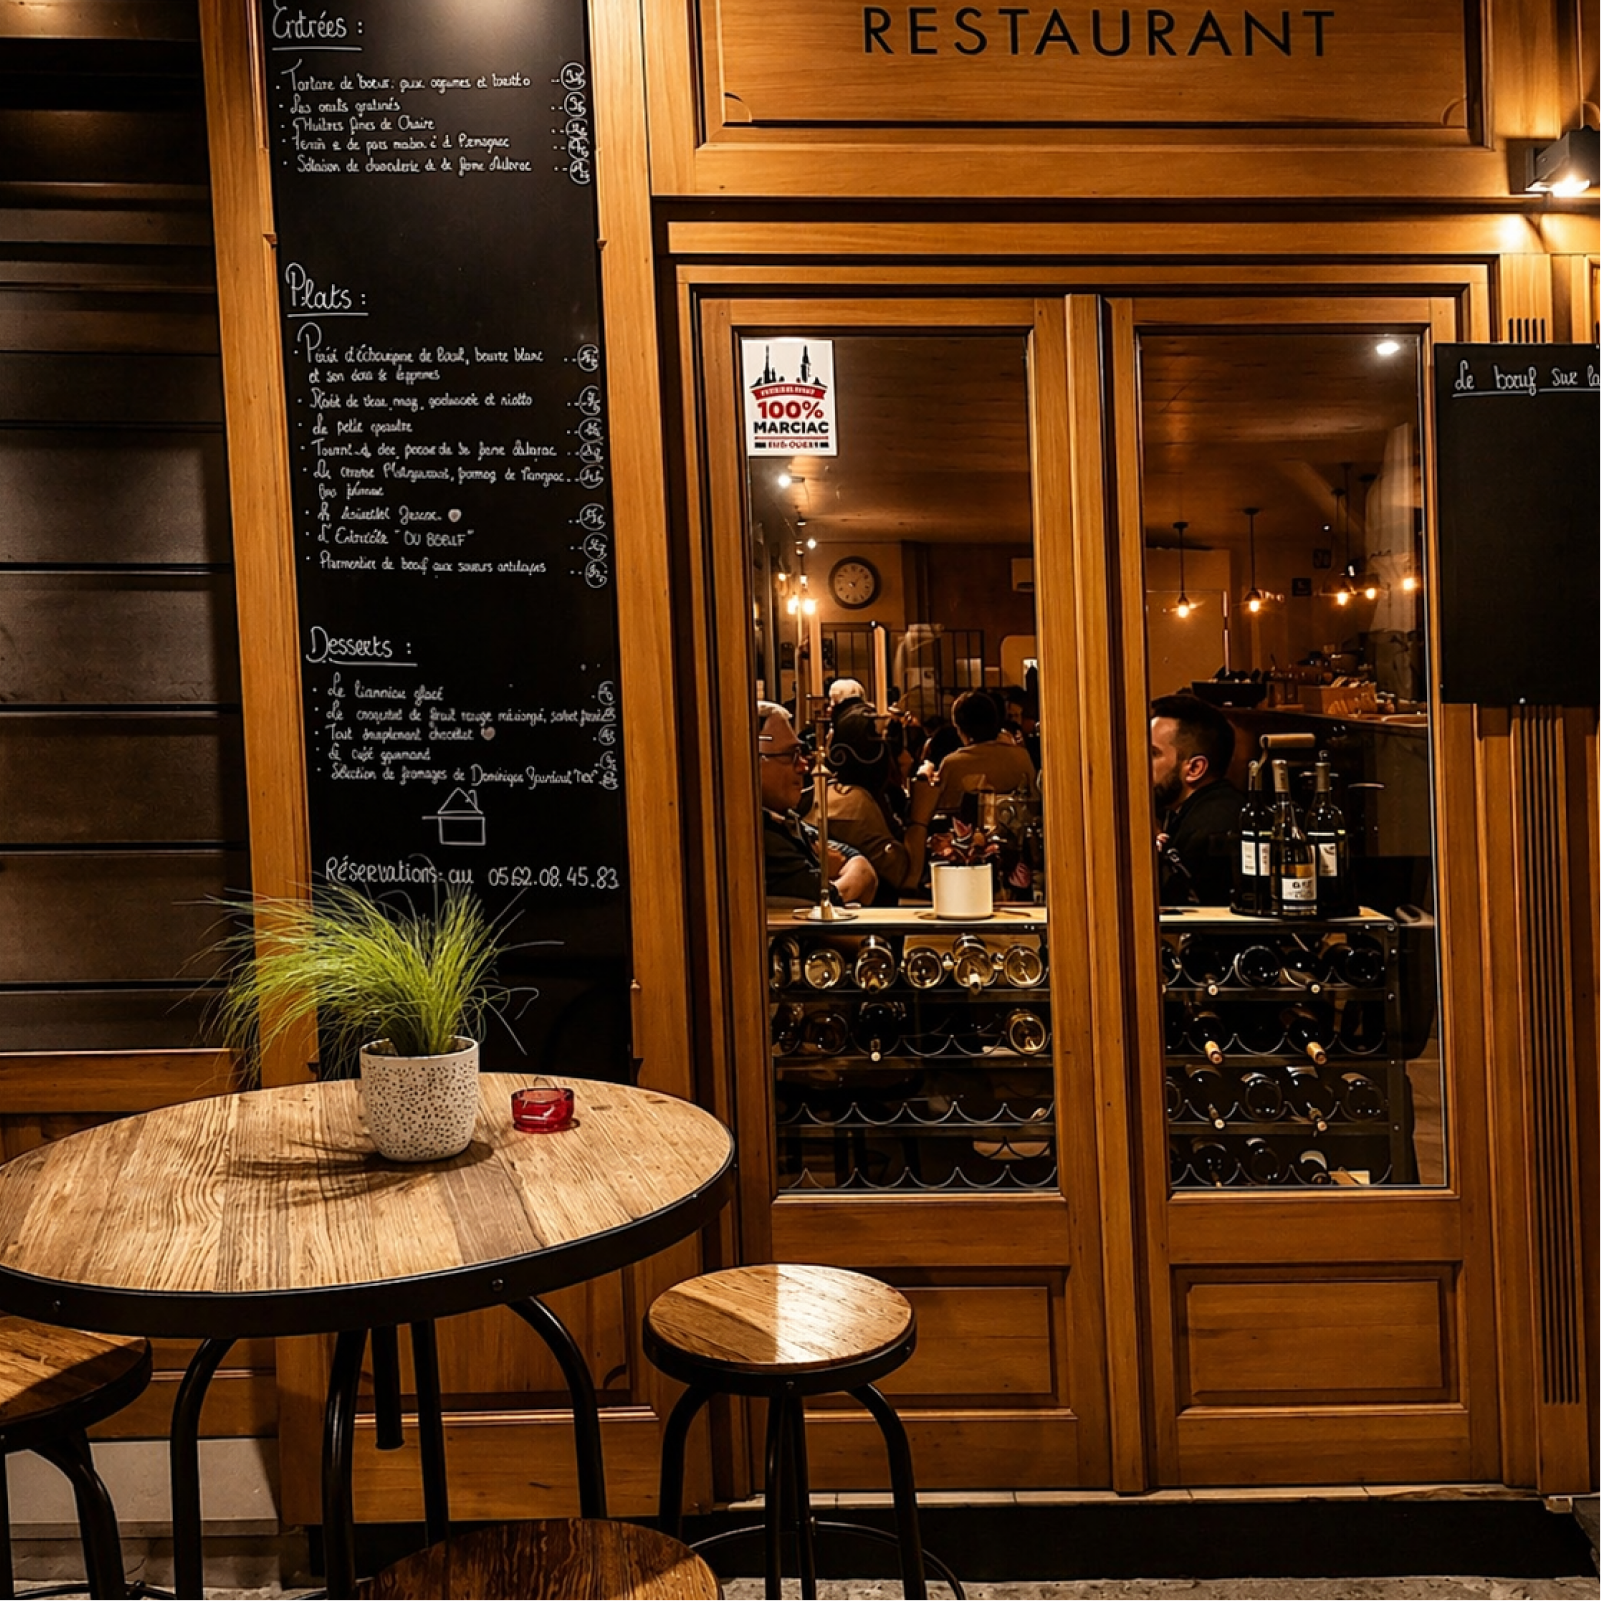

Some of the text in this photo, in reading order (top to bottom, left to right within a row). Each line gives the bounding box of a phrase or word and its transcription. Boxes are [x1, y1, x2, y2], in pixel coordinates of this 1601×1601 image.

[272, 0, 347, 39] Entrées
[863, 7, 1335, 57] RESTAURANT
[340, 76, 355, 90] de
[380, 117, 393, 130] de
[346, 137, 360, 150] de
[285, 262, 352, 308] Plats
[757, 401, 824, 420] 100%
[753, 421, 829, 434] MARCIAC
[381, 556, 395, 570] de
[306, 625, 393, 662] Desserts
[382, 766, 395, 780] de
[453, 767, 465, 781] de
